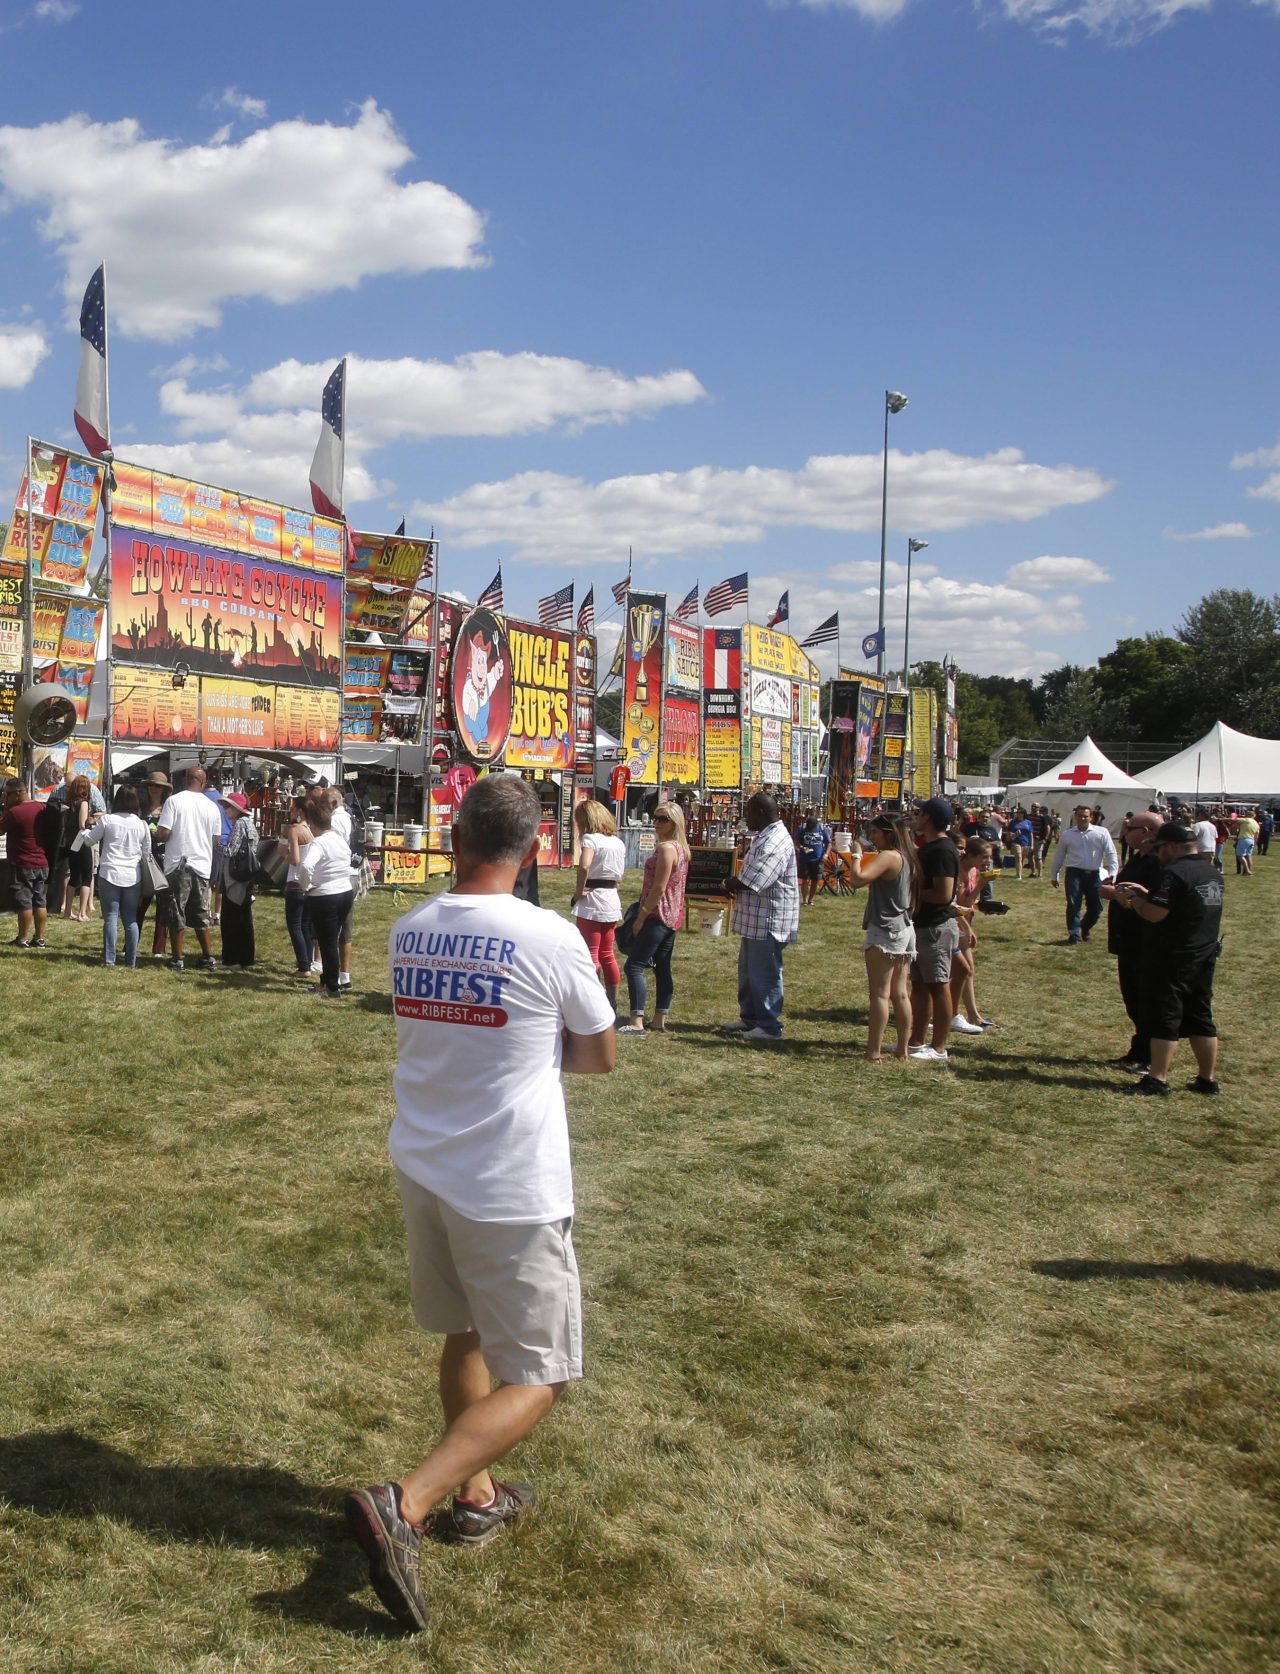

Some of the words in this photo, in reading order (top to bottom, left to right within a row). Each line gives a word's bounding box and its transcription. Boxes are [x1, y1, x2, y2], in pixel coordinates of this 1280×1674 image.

[131, 539, 245, 601] HOWLING
[250, 566, 327, 630] COYOTE
[180, 597, 210, 609] BBQ
[219, 601, 284, 623] COMPANY
[509, 629, 570, 691] UNCLE
[677, 657, 699, 678] SAUCE
[511, 685, 569, 740] BUB'S
[395, 931, 516, 965] VOLUNTEER
[431, 959, 478, 971] EXCHANGE
[479, 963, 513, 976] CLUB'S
[393, 967, 510, 1006] RIBFEST
[397, 1004, 496, 1024] www.RIBFEST.net
